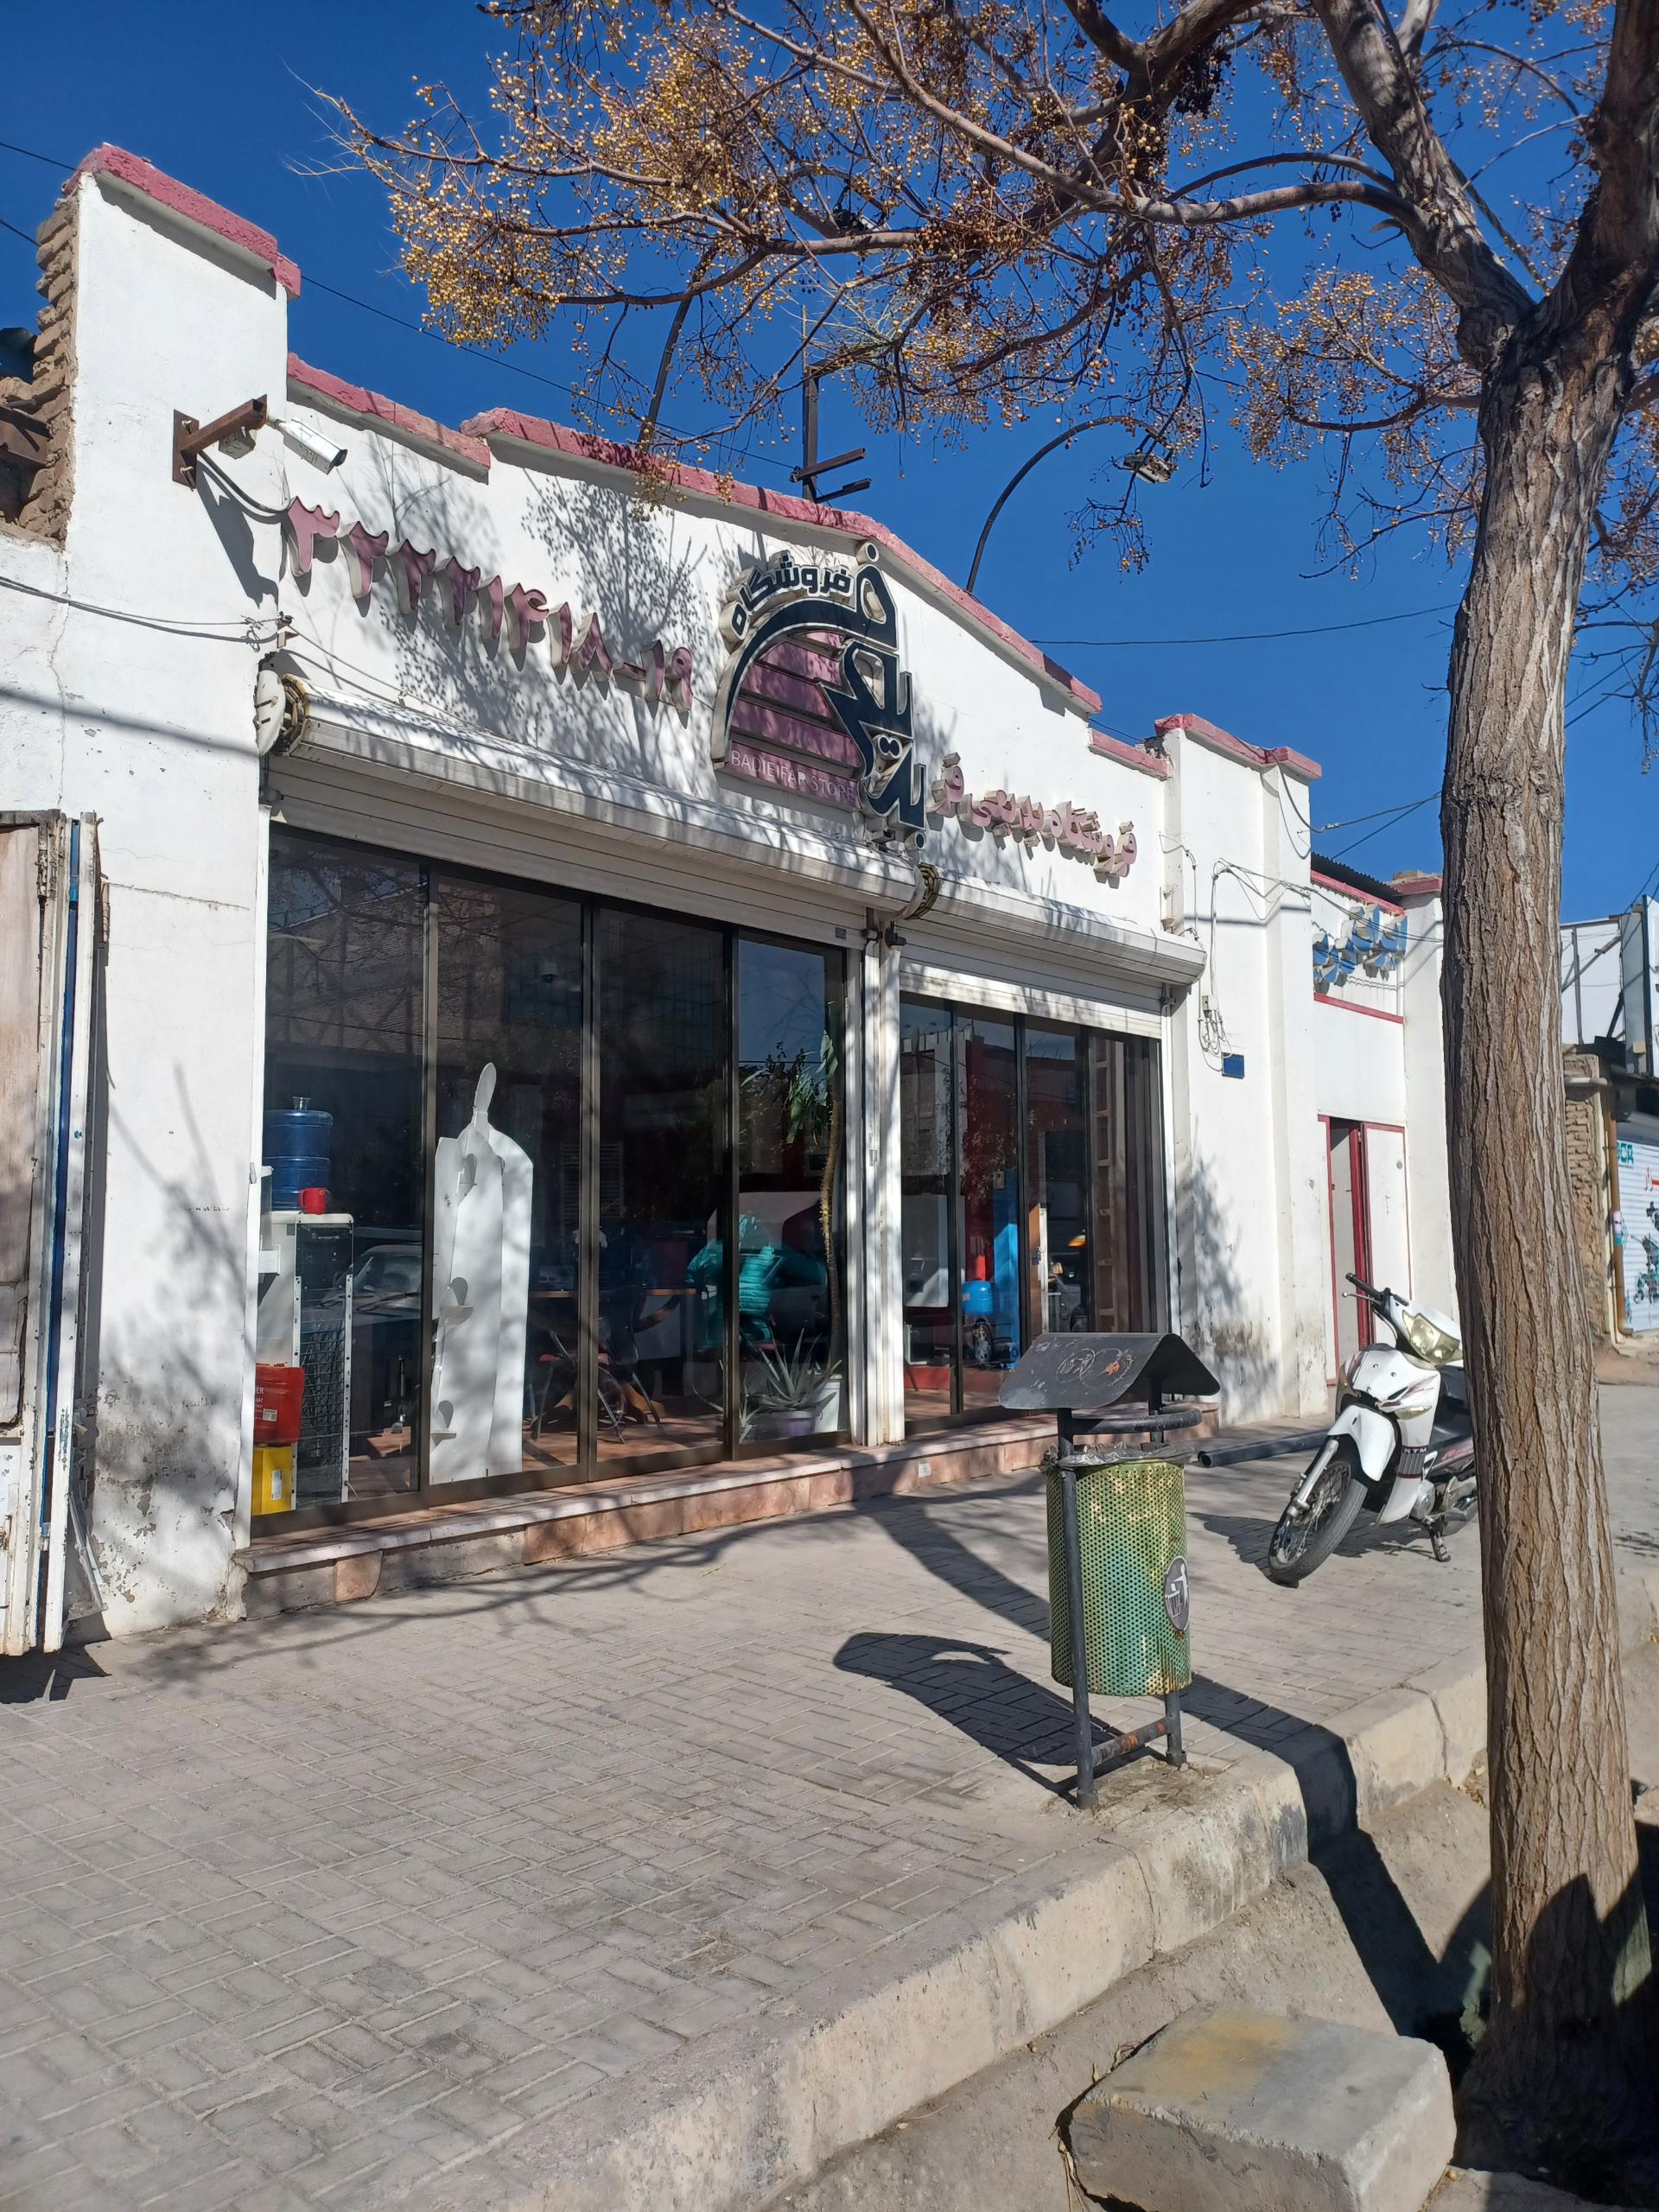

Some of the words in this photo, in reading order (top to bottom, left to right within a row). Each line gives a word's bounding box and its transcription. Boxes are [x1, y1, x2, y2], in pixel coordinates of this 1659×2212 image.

[728, 549, 855, 640] فروشگاه
[731, 749, 807, 787] BADIEIFAR
[810, 774, 855, 802] STORE
[1046, 800, 1137, 877] فروشگاه
